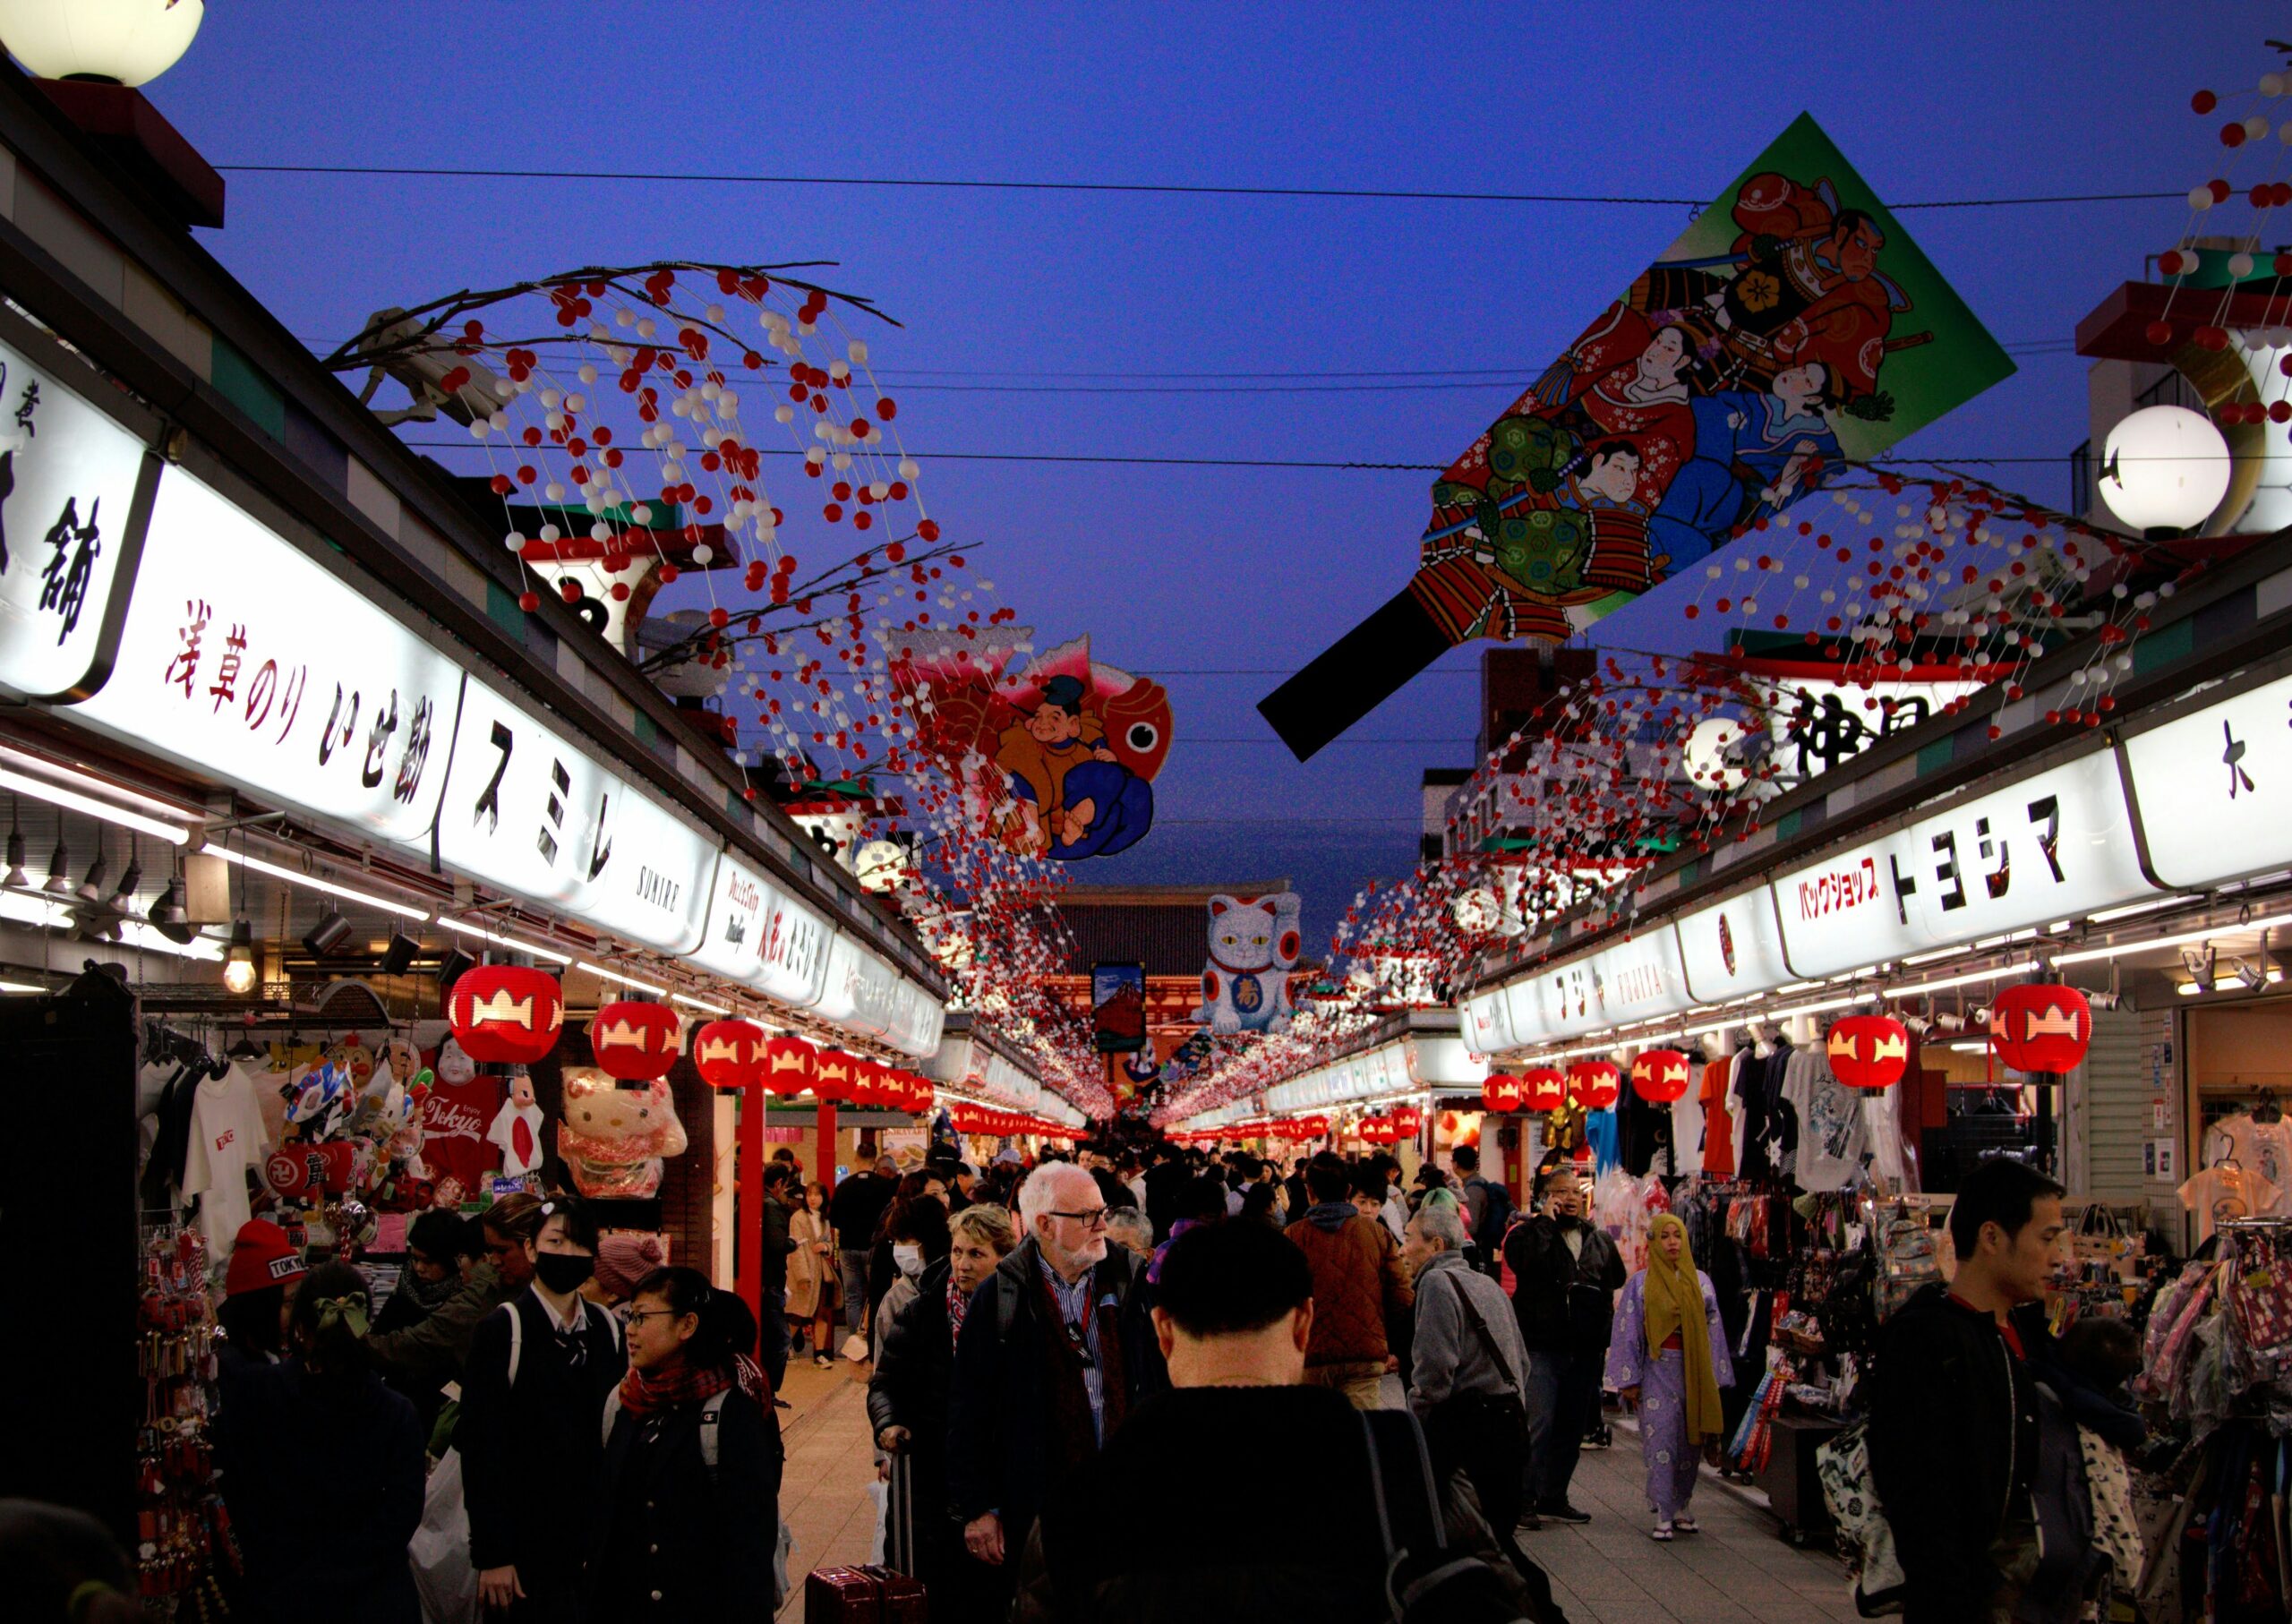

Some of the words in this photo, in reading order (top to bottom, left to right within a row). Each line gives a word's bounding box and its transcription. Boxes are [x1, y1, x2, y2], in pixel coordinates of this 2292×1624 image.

[165, 599, 306, 746] 浅草のり
[474, 719, 612, 883] スミレ
[1890, 793, 2066, 925] トヨシマ
[637, 865, 680, 913] SUMIRE
[1555, 965, 1605, 1021] フジヤ
[1617, 962, 1663, 1005] FUJIYA
[423, 1095, 483, 1138] Tokyo
[462, 1104, 482, 1116] Enjoy
